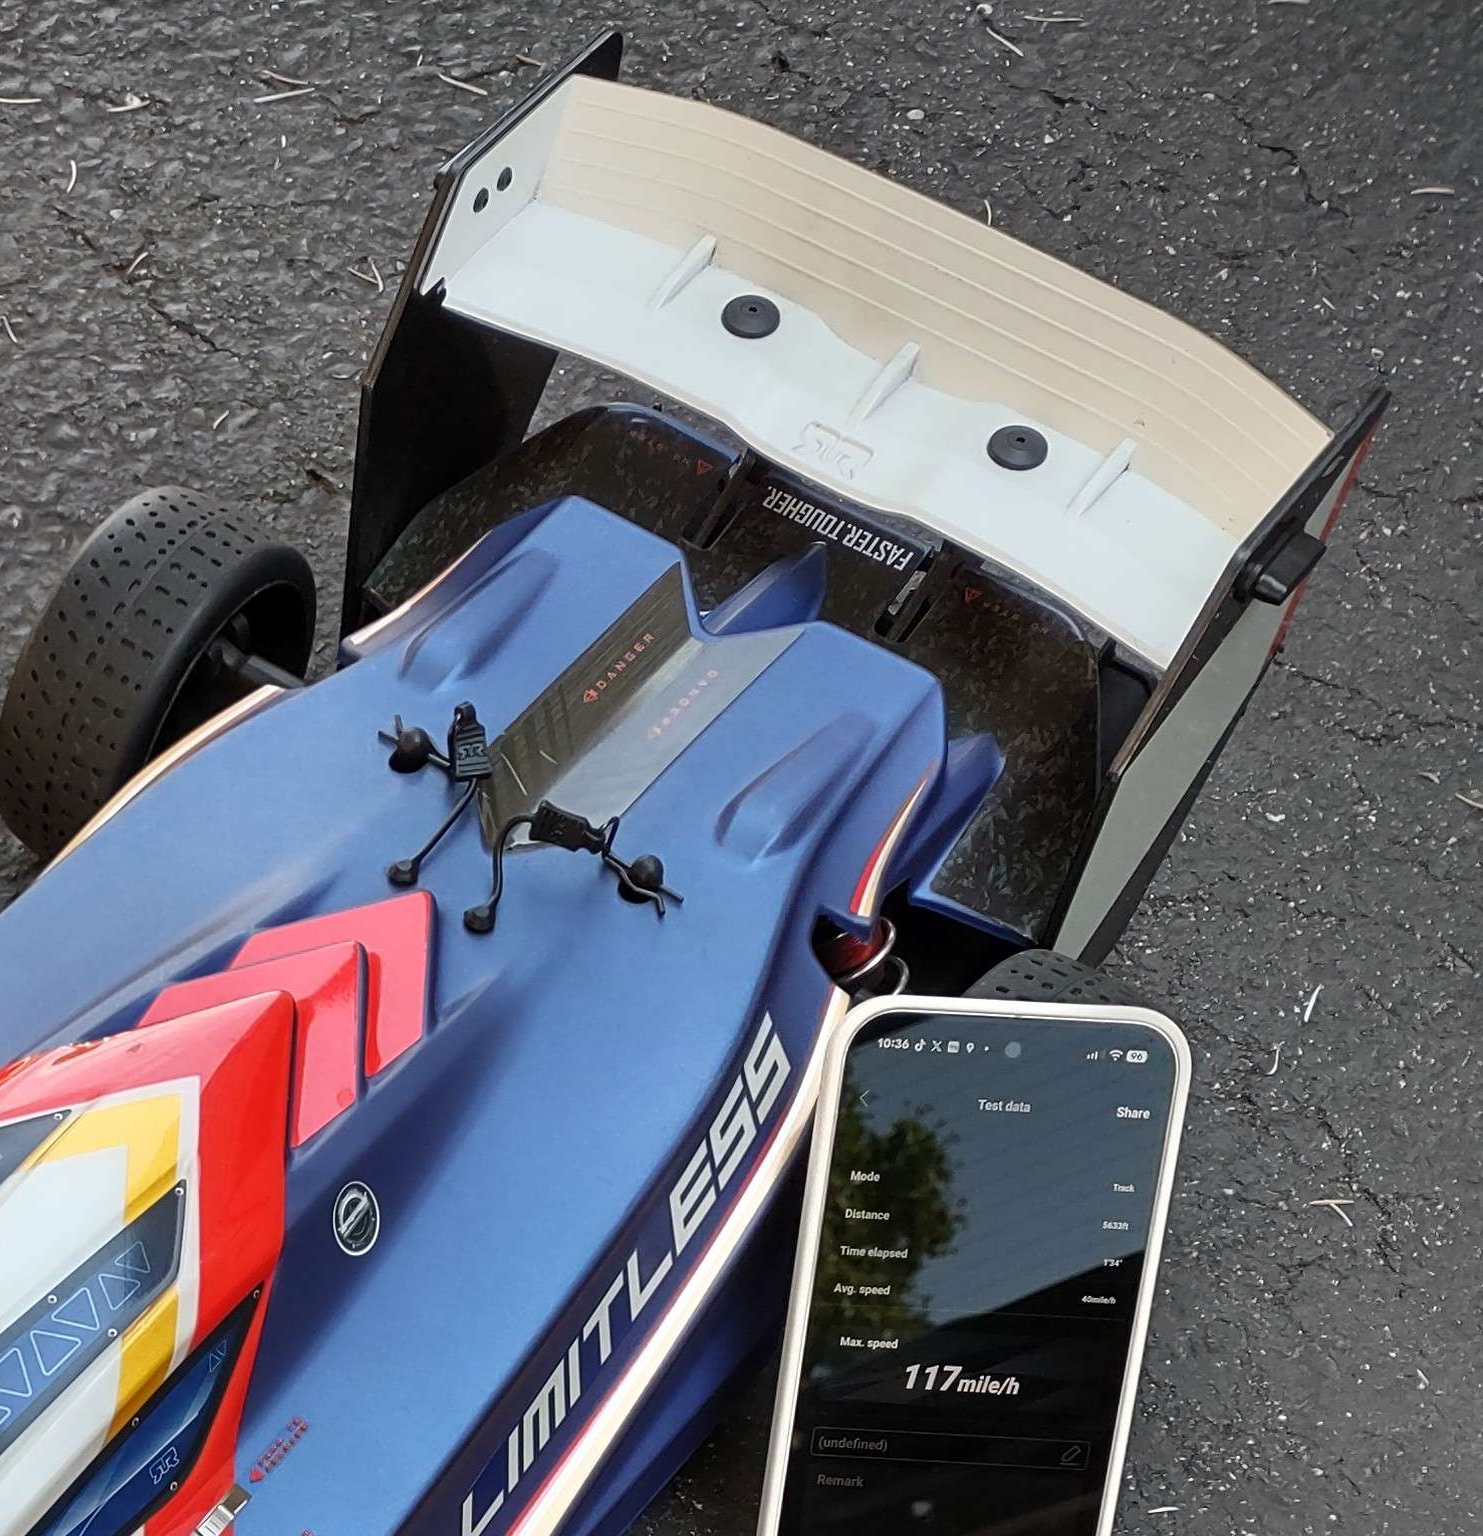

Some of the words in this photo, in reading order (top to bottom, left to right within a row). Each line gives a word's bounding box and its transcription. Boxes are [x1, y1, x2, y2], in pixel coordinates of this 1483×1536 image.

[596, 632, 655, 690] DANGER
[877, 1037, 910, 1050] 10:36
[977, 1099, 1003, 1111] Test
[1005, 1100, 1031, 1114] data
[1116, 1106, 1151, 1120] Share
[850, 1170, 880, 1182] Mode
[1113, 1183, 1135, 1193] Track
[845, 1208, 890, 1221] Distance
[840, 1245, 866, 1257] Time
[868, 1247, 909, 1260] elapsed
[834, 1283, 857, 1296] Avg.
[859, 1285, 891, 1297] speed
[840, 1336, 865, 1348] Max.
[867, 1338, 899, 1350] speed
[818, 1435, 888, 1452] (undefined)
[817, 1474, 864, 1488] Remark
